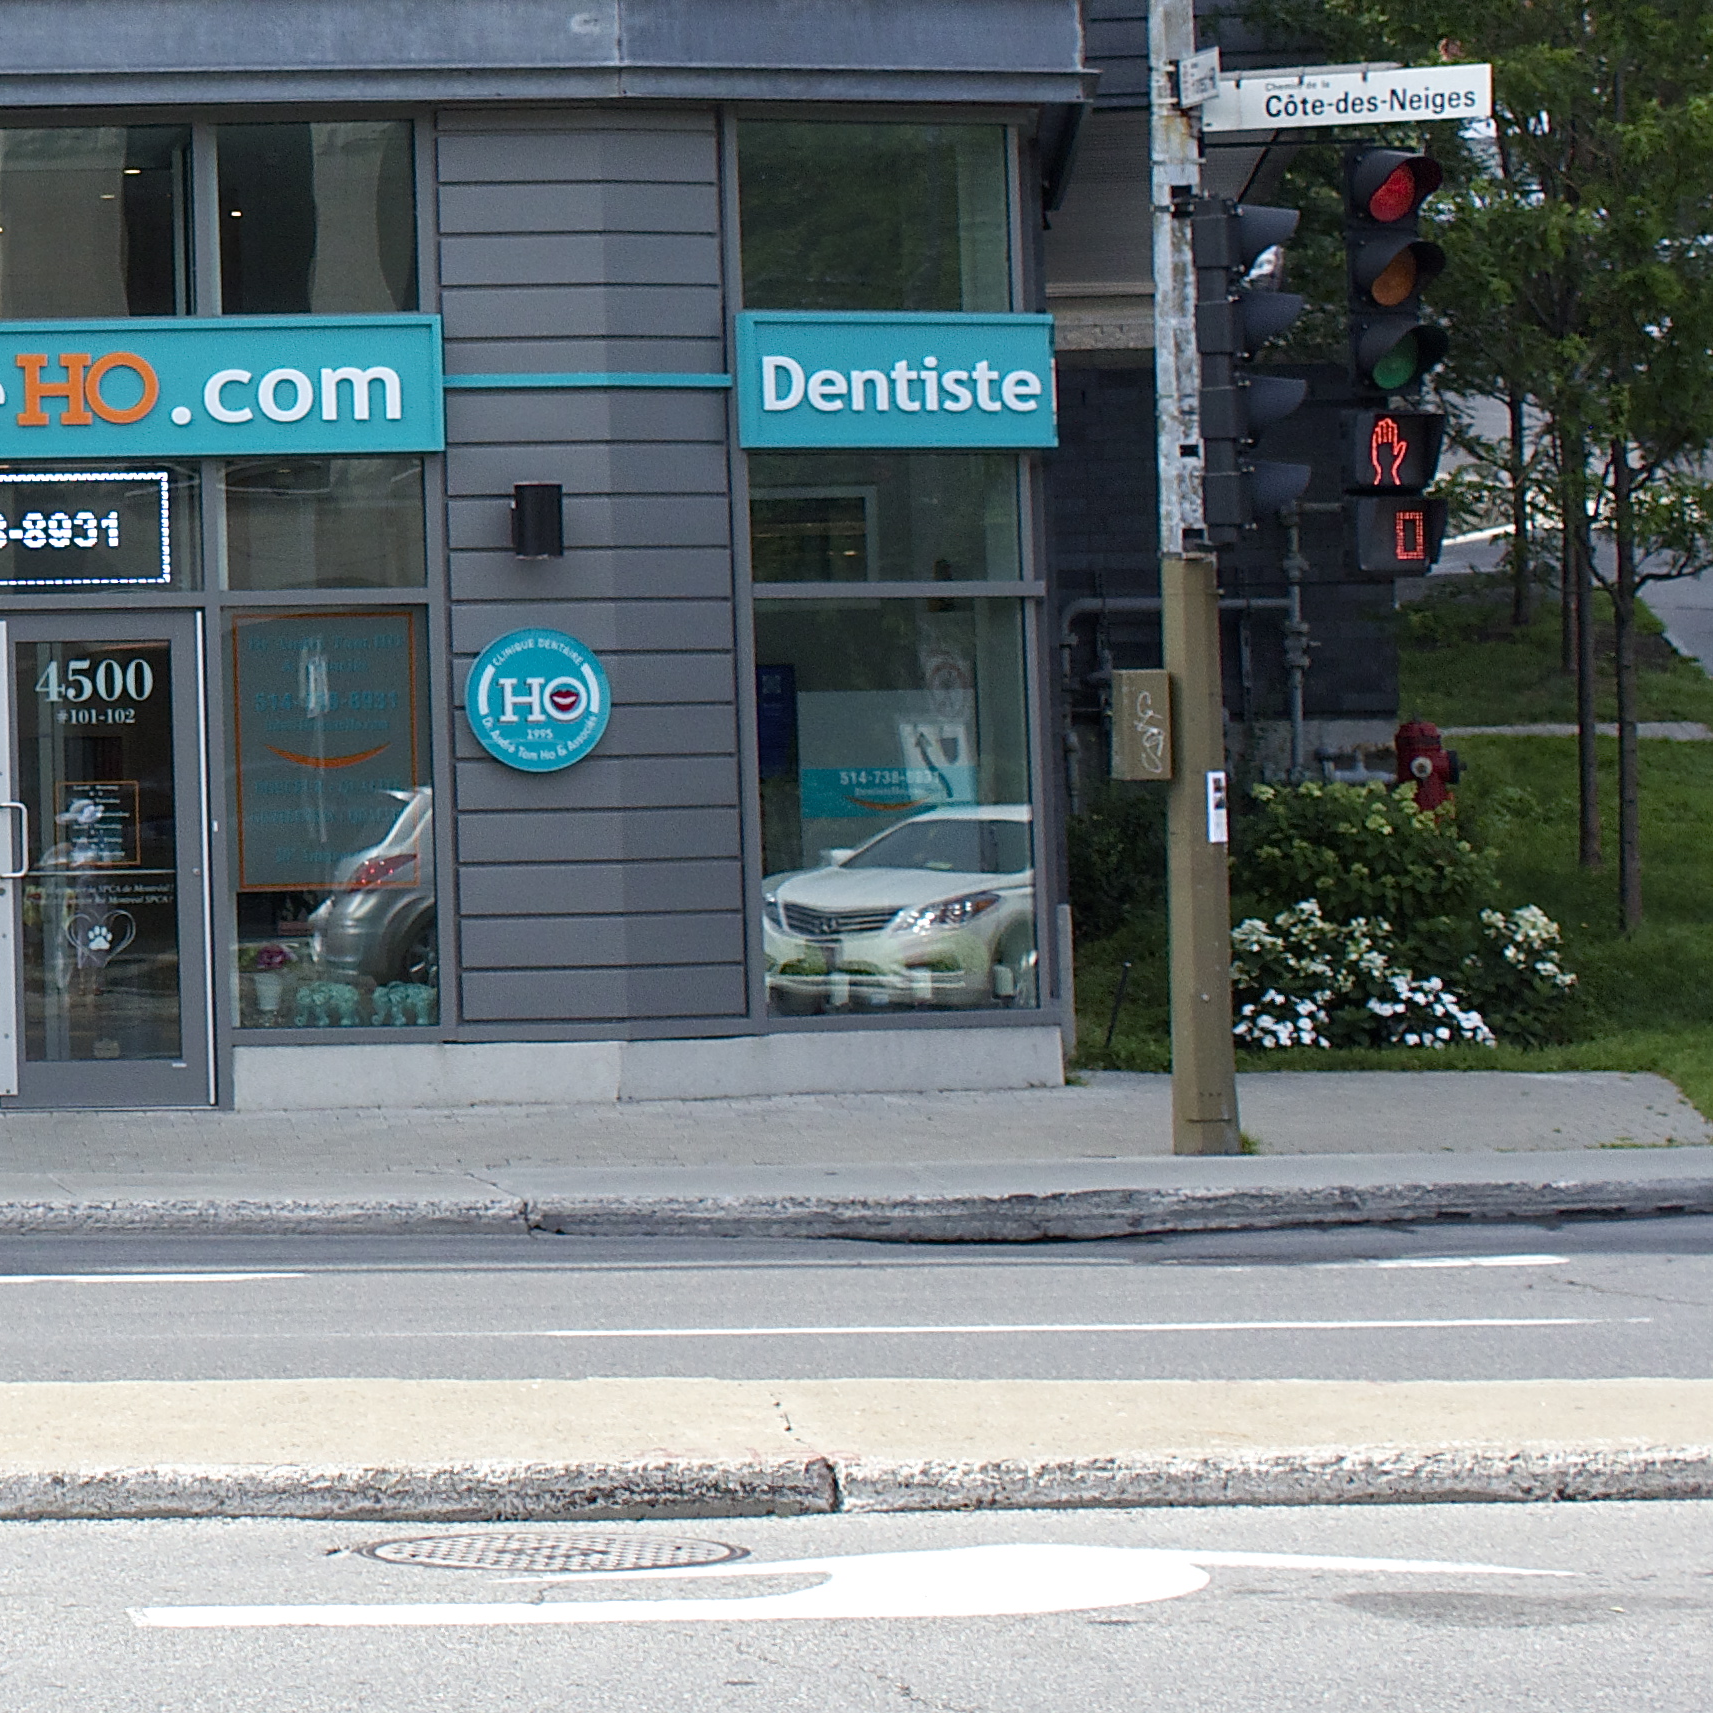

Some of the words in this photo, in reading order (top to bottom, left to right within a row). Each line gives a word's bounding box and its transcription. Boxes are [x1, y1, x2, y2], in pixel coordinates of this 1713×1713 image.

[1265, 88, 1476, 118] Côte-des-Neiges
[762, 356, 1042, 412] Dentiste
[492, 638, 535, 666] CLINIQUE
[537, 638, 584, 666] DENTAIRE
[35, 658, 154, 703] 4500
[498, 676, 588, 722] HO
[56, 708, 136, 725] #101-102
[526, 728, 554, 740] 1995
